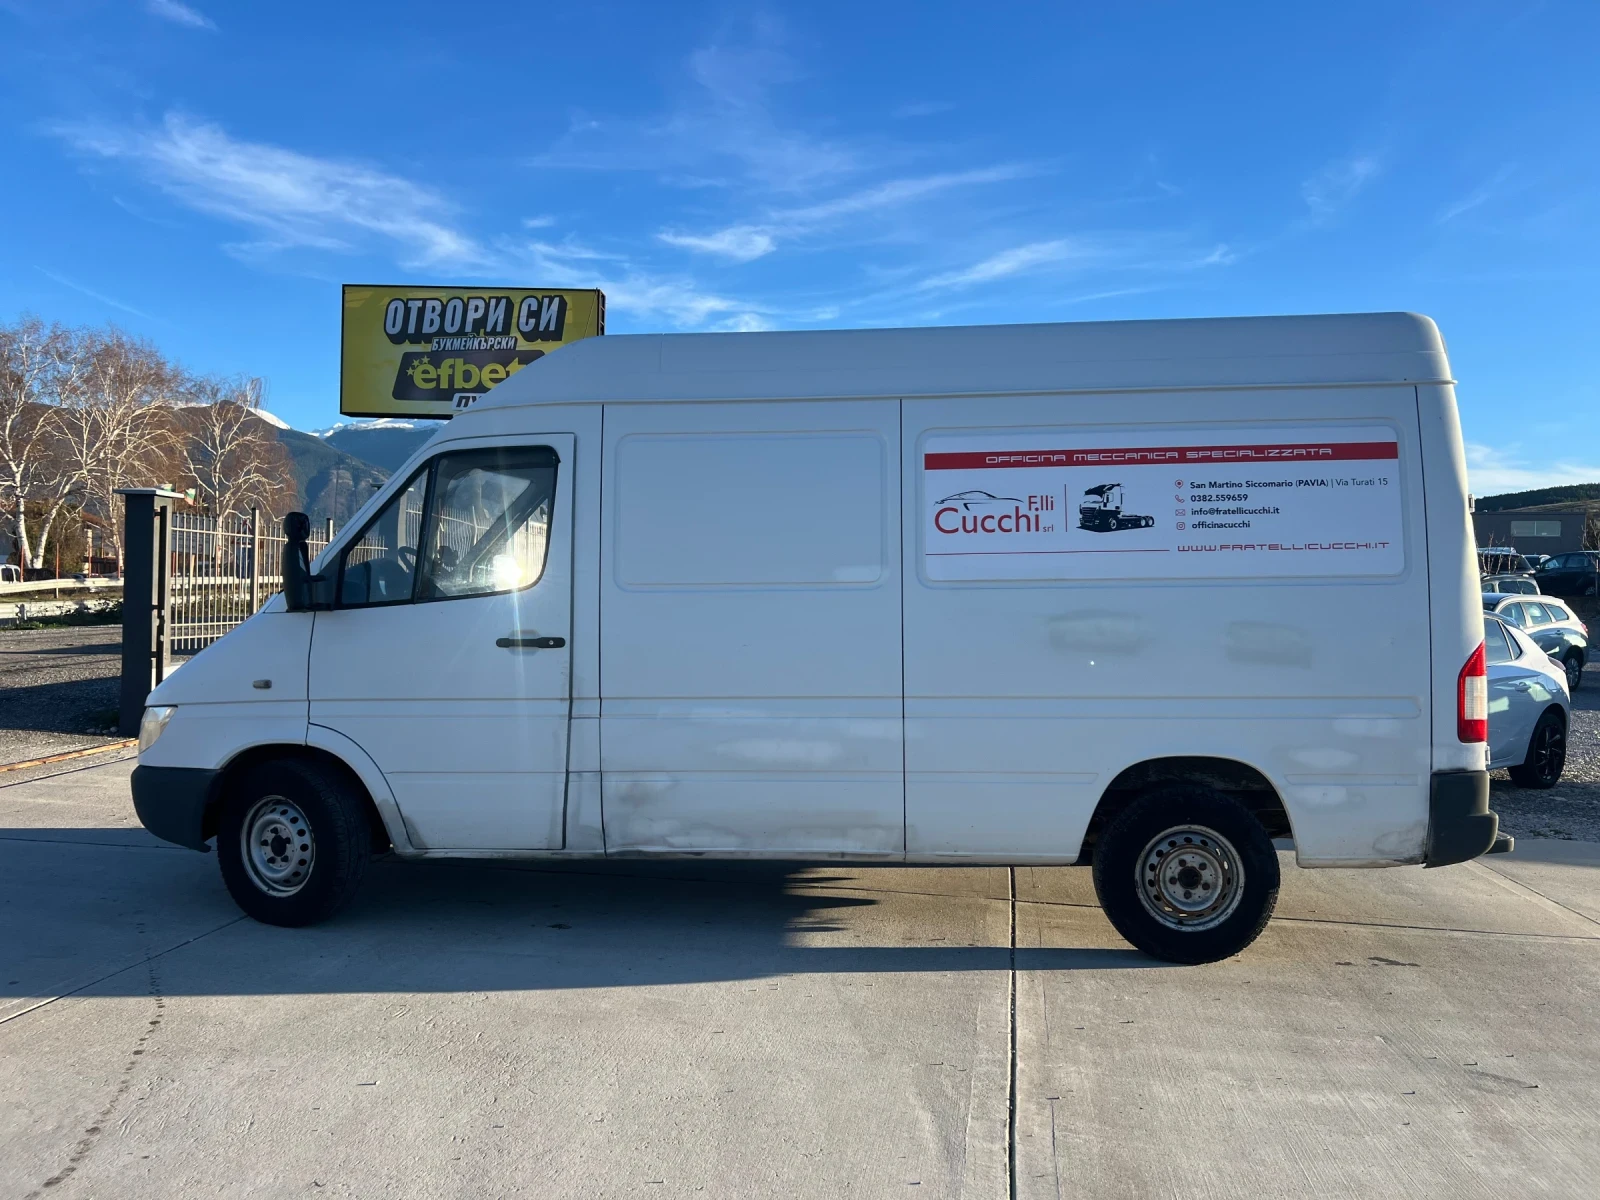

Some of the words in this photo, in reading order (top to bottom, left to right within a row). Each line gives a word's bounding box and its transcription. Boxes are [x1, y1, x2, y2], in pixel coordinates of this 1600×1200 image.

[385, 297, 507, 335] ОТВОРИ
[517, 296, 562, 333] СИ
[432, 335, 516, 351] БУКМЕЙКЪРСКИ
[985, 454, 1066, 464] OFFICINA
[1073, 451, 1178, 462] MECCANICA
[1186, 448, 1332, 459] SPECIALIZZATA
[1190, 481, 1206, 489] San
[1245, 480, 1293, 488] Siccomario
[1295, 479, 1329, 487] (PAVIA)
[1351, 478, 1375, 486] Turati
[1377, 478, 1388, 486] 15
[1190, 494, 1248, 502] 0382.559659
[1191, 507, 1280, 516] info@fratellicucchi.it
[934, 506, 1040, 534] Cucchi
[1042, 524, 1054, 533] srl
[1191, 521, 1251, 529] officinacucchi
[1177, 542, 1390, 552] WWW.FRATELLICUCCHI.IT
